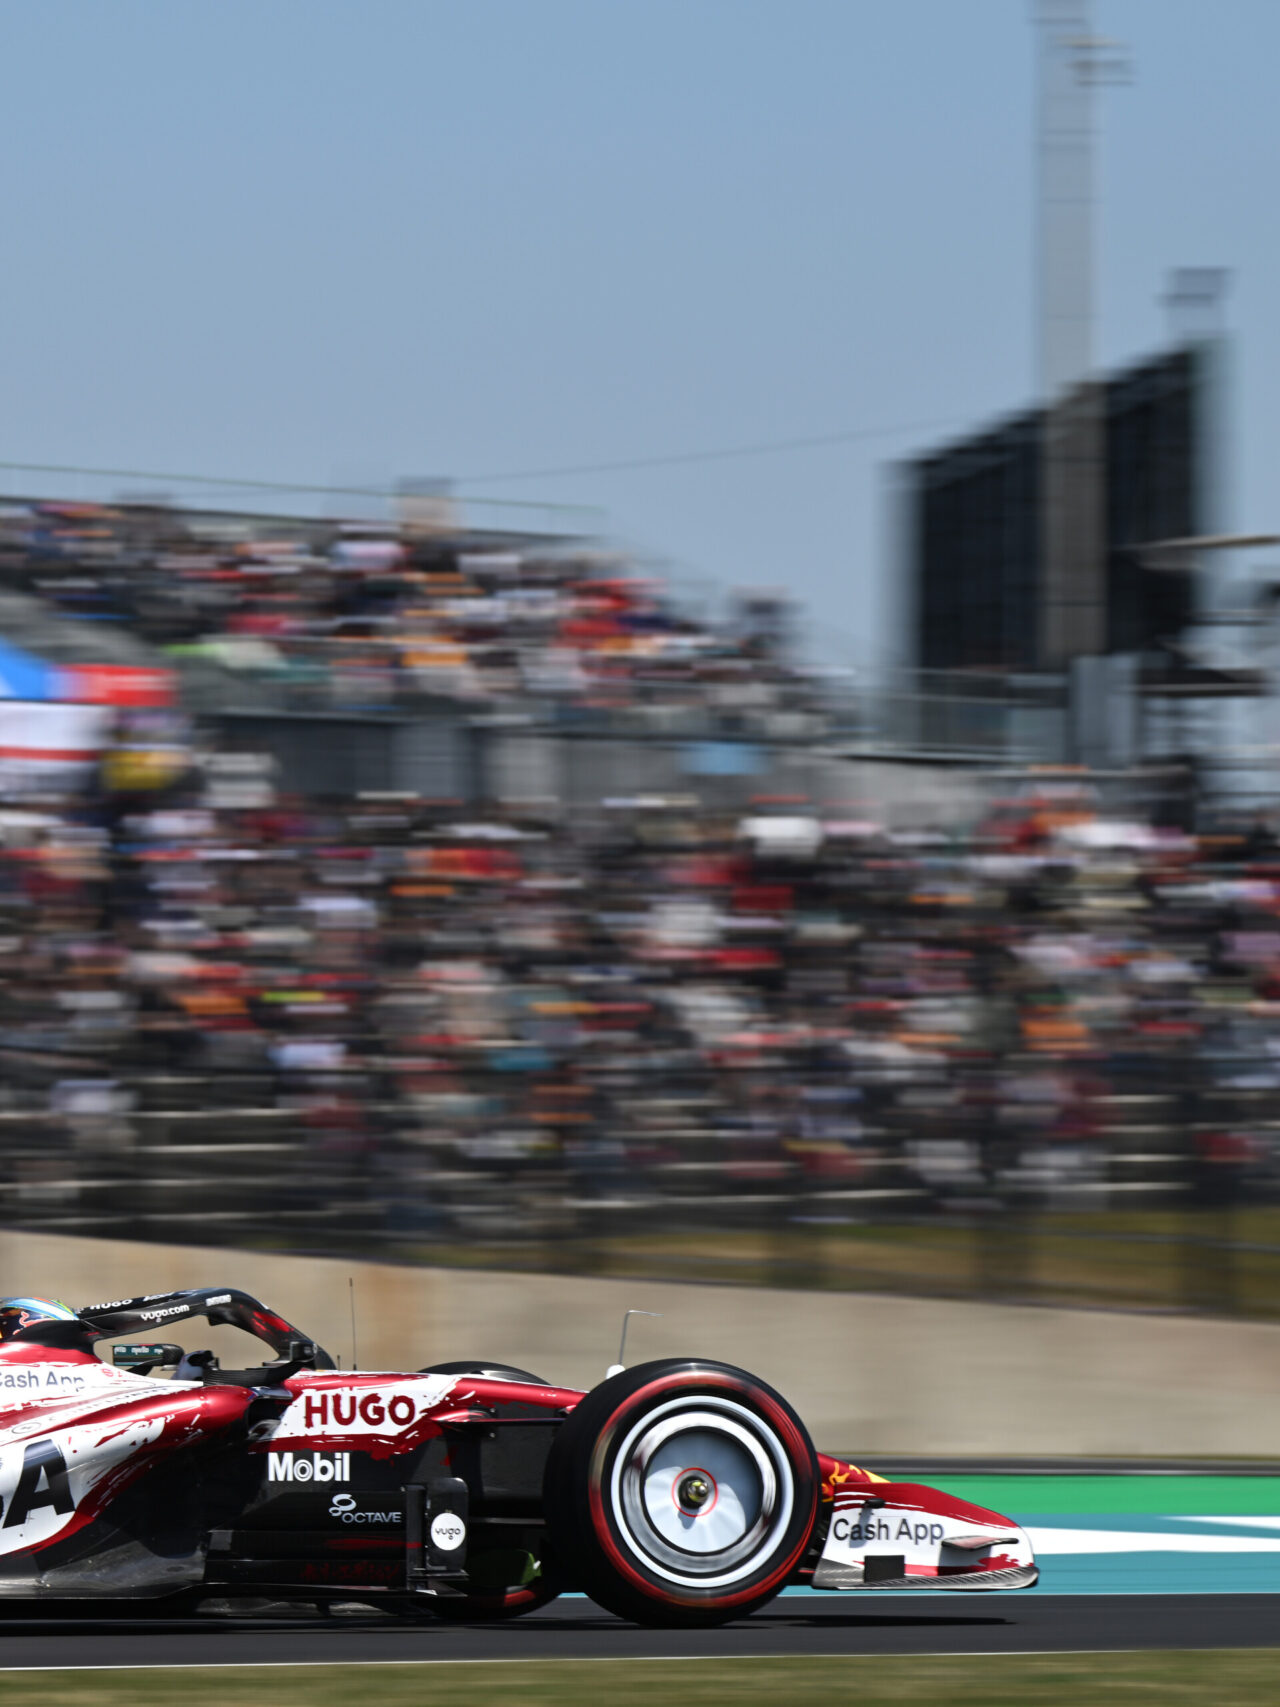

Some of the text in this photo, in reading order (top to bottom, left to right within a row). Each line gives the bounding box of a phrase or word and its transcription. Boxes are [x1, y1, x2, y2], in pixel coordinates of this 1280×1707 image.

[304, 1391, 416, 1428] HUGO
[267, 1452, 351, 1482] Mobil
[341, 1511, 402, 1524] OCTAVE
[833, 1518, 944, 1546] Cash App
